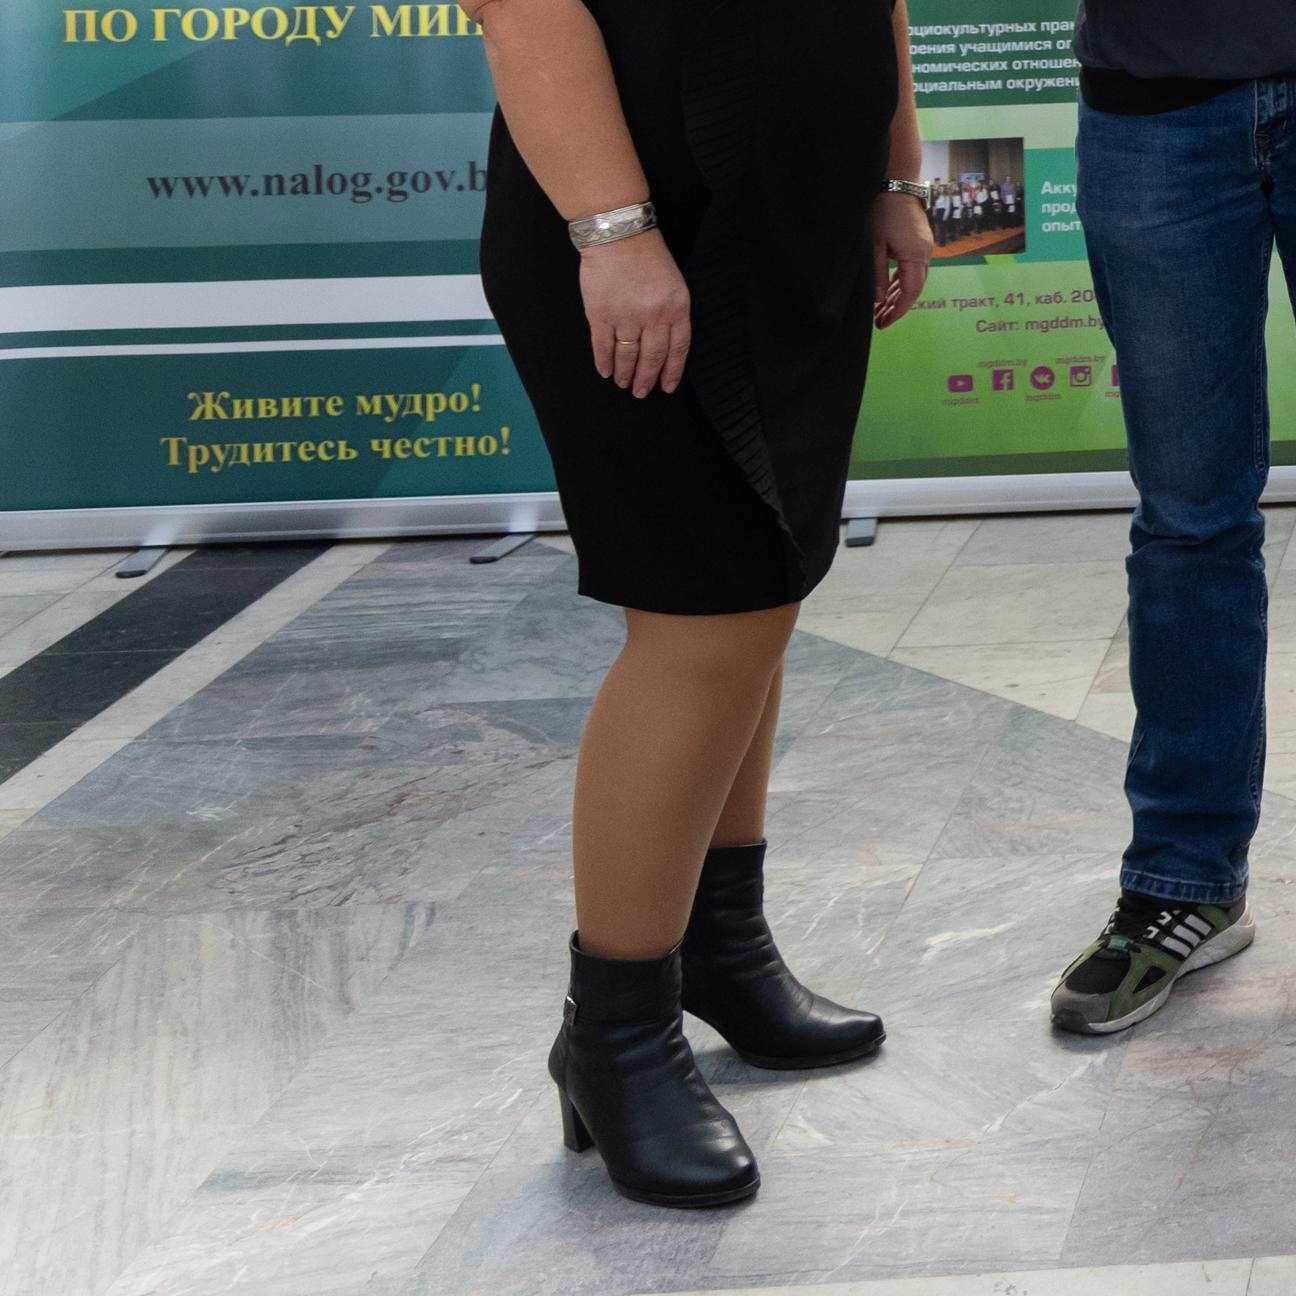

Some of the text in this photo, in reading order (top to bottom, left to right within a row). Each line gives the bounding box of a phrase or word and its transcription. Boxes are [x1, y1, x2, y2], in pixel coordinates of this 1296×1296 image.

[62, 9, 138, 43] ПО
[152, 6, 354, 46] ГОРОДУ
[959, 39, 1052, 56] учащимися
[186, 383, 481, 422] Живите мудро!
[160, 426, 511, 473] Трудитесь честно!
